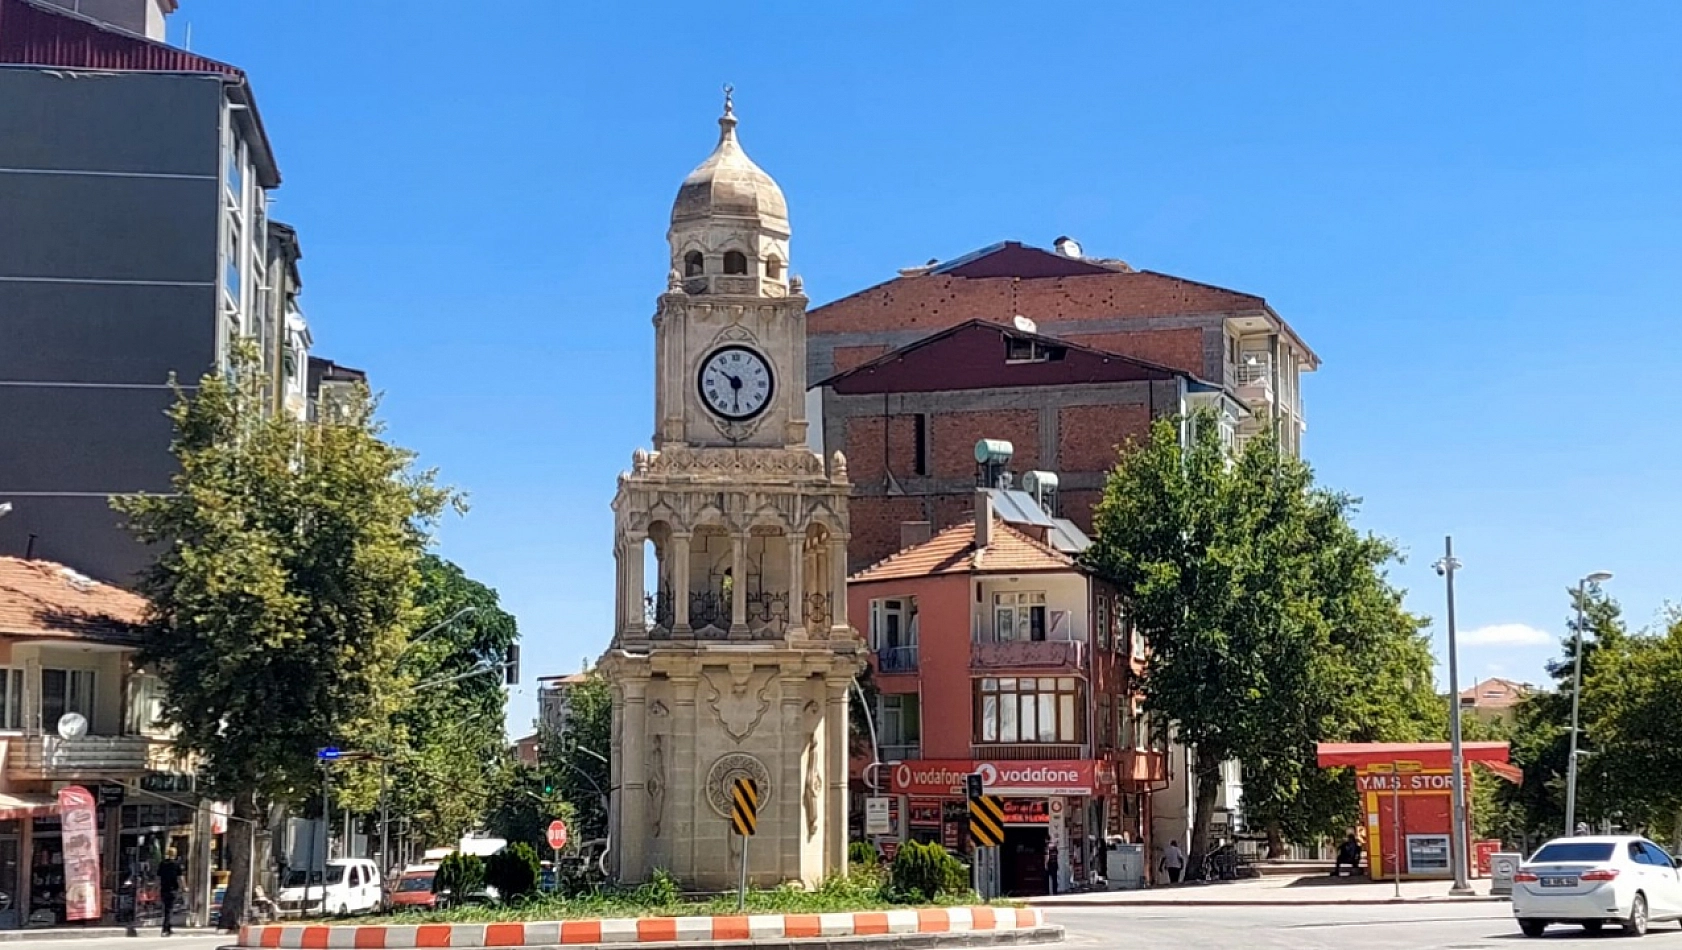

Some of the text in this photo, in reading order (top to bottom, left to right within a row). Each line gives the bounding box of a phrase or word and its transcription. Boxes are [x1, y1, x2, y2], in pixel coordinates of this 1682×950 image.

[912, 767, 967, 785] vodafone
[1000, 767, 1079, 783] vodafone
[1359, 776, 1406, 790] Y.M.S.
